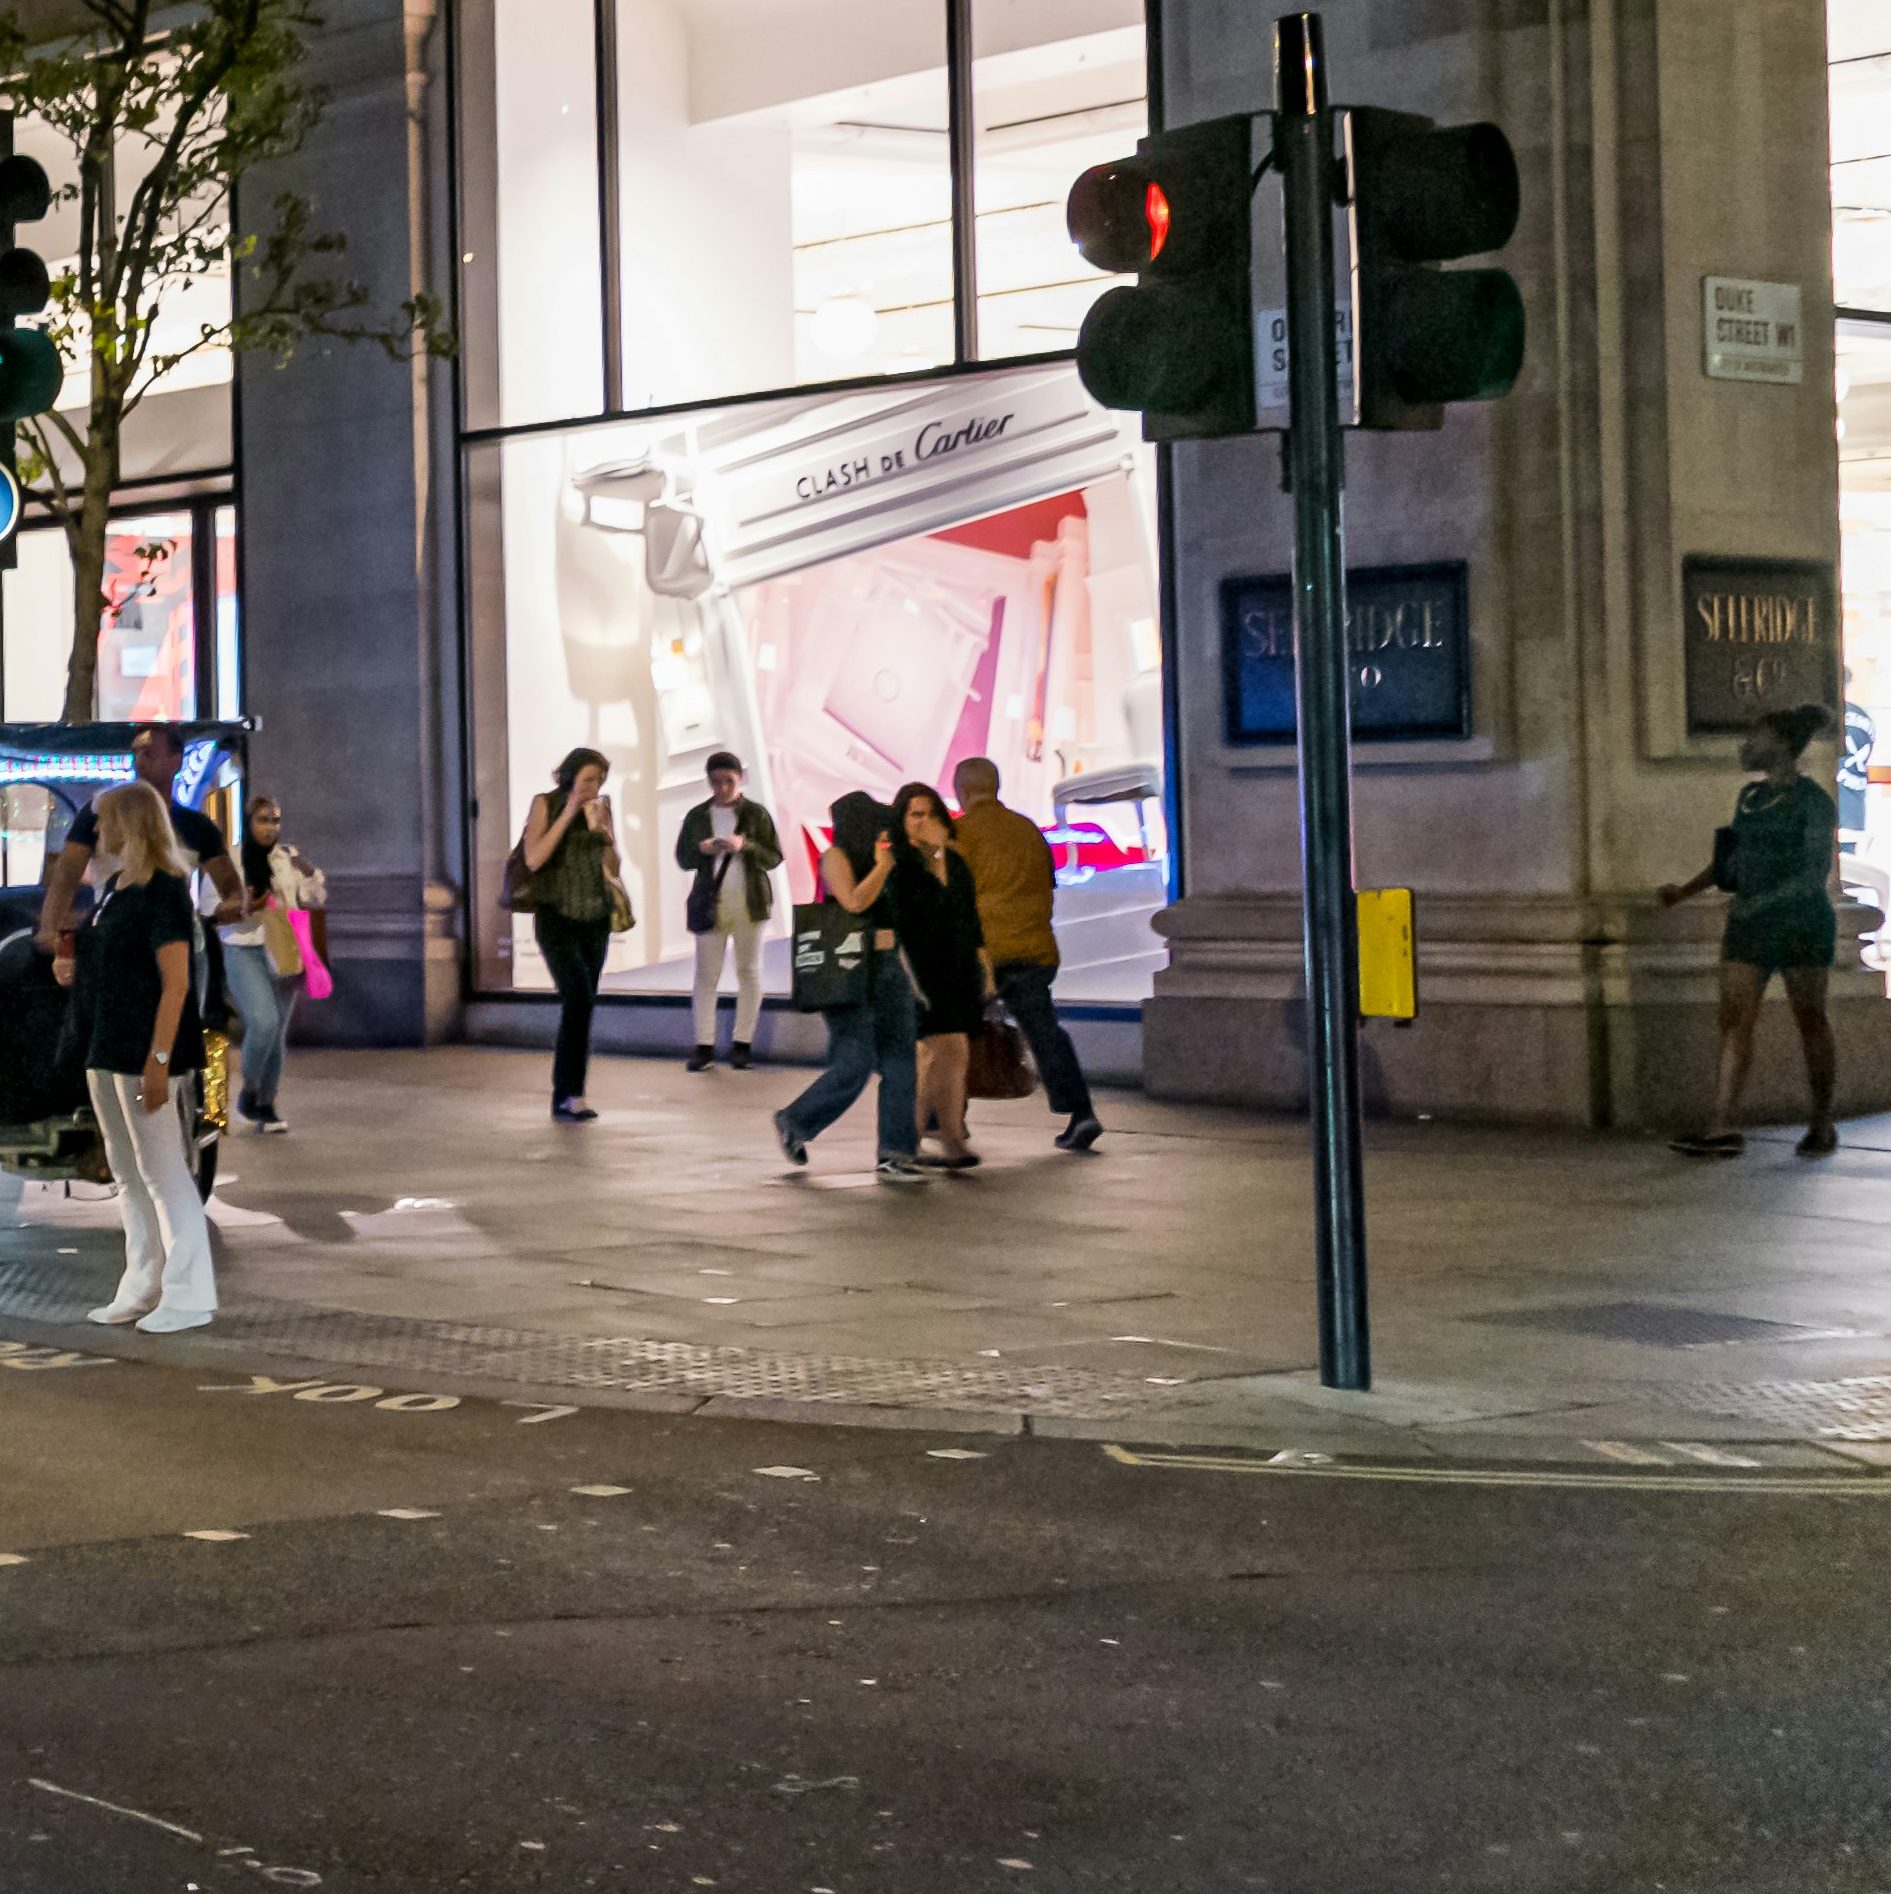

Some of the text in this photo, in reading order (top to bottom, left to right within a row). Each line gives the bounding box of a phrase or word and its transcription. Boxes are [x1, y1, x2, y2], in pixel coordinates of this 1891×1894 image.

[1714, 286, 1754, 314] DUKE
[1716, 317, 1770, 346] STREET
[795, 412, 1015, 500] CLASH DE Cartier
[1242, 601, 1444, 658] SEIDGE
[1696, 593, 1819, 645] SELFRIDGE
[196, 1374, 581, 1424] LOOK
